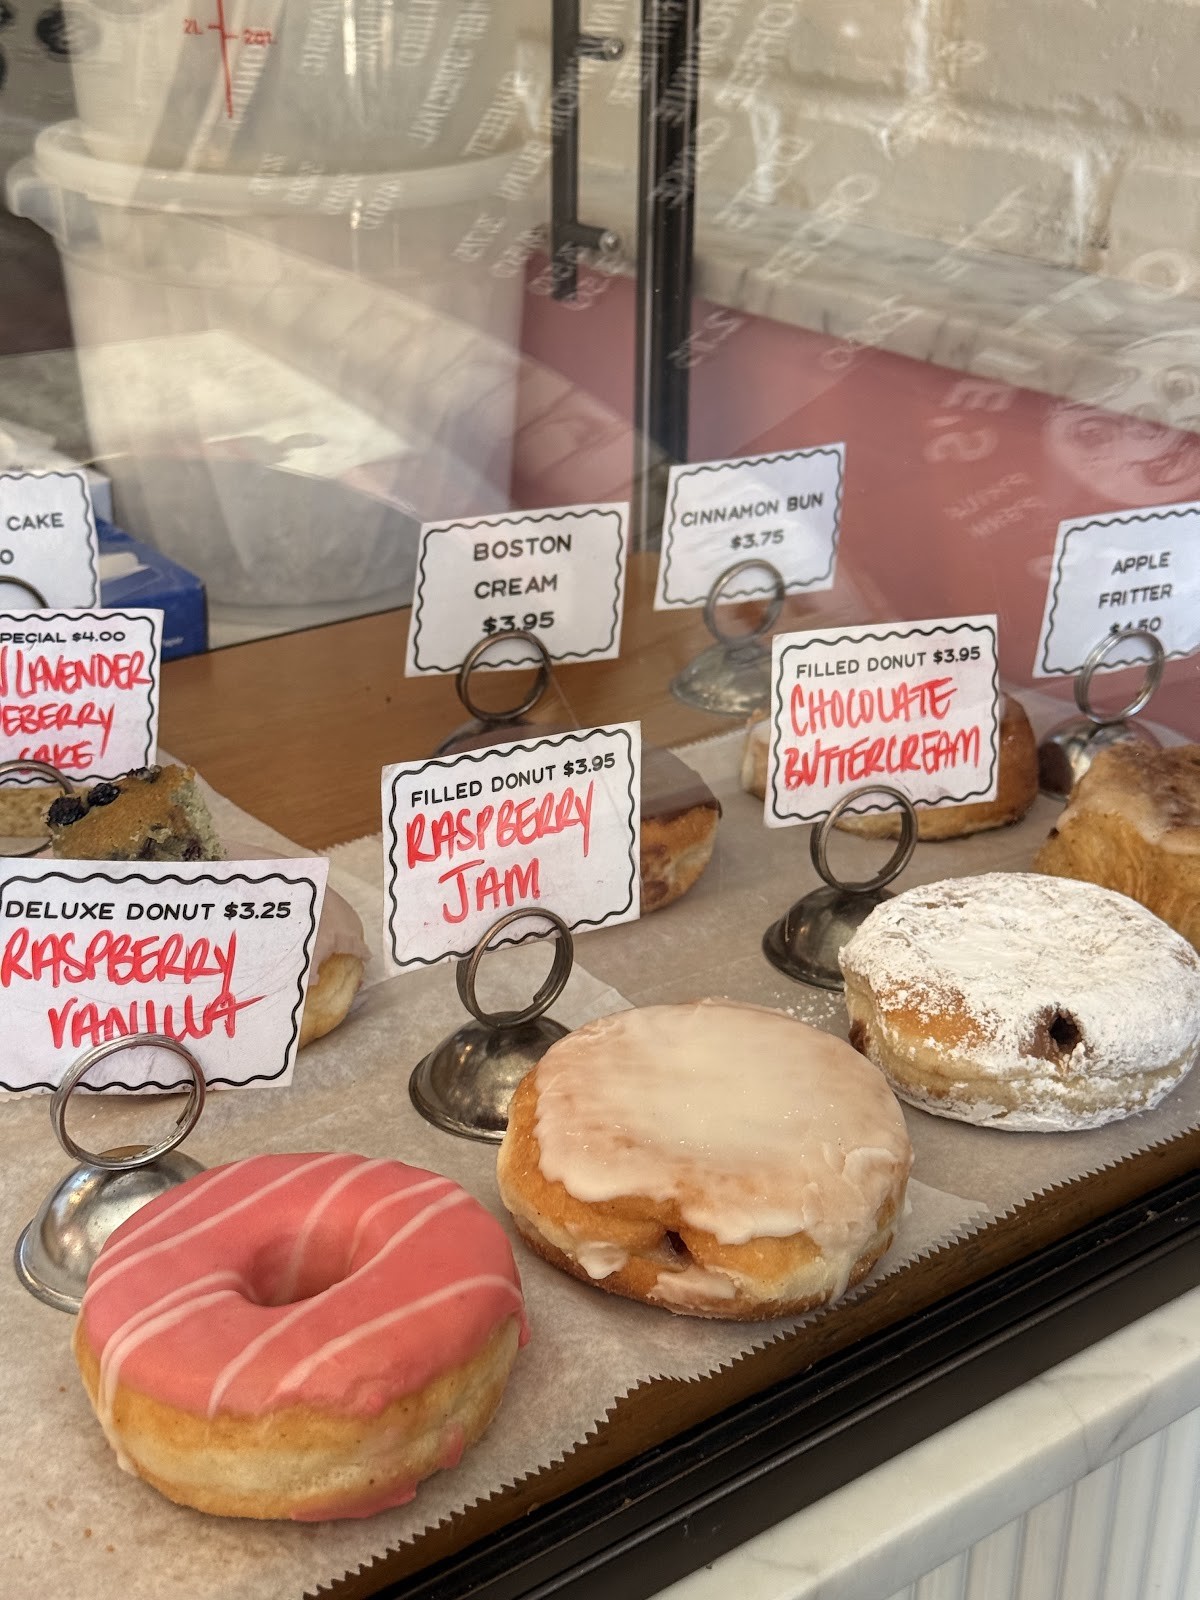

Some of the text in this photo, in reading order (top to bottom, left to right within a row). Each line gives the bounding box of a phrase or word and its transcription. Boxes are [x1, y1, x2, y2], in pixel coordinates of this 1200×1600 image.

[7, 512, 64, 531] CAKE
[681, 492, 824, 527] CINNAMON BUN
[473, 534, 572, 561] BOSTON
[730, 529, 784, 550] $3.75
[1111, 551, 1171, 575] APPLE
[474, 574, 558, 599] CREAM
[1098, 583, 1173, 609] FRITTER
[72, 631, 126, 642] $4.00
[482, 611, 555, 634] $3.95
[16, 649, 153, 699] LAVENDER
[796, 646, 980, 678] FILLED DONUT $3.95
[790, 677, 958, 736] CHOCOLATE
[0, 701, 115, 759] EBERRY
[784, 725, 980, 791] BUTTERCREAM
[411, 752, 616, 808] FILLED DONUT $3.95
[406, 779, 595, 869] RASPBERRY
[438, 857, 541, 923] JAM
[5, 900, 292, 920] DELUXE DONUT $3.25
[1, 927, 237, 995] RASPBERRY
[48, 993, 267, 1049] VANILLA
